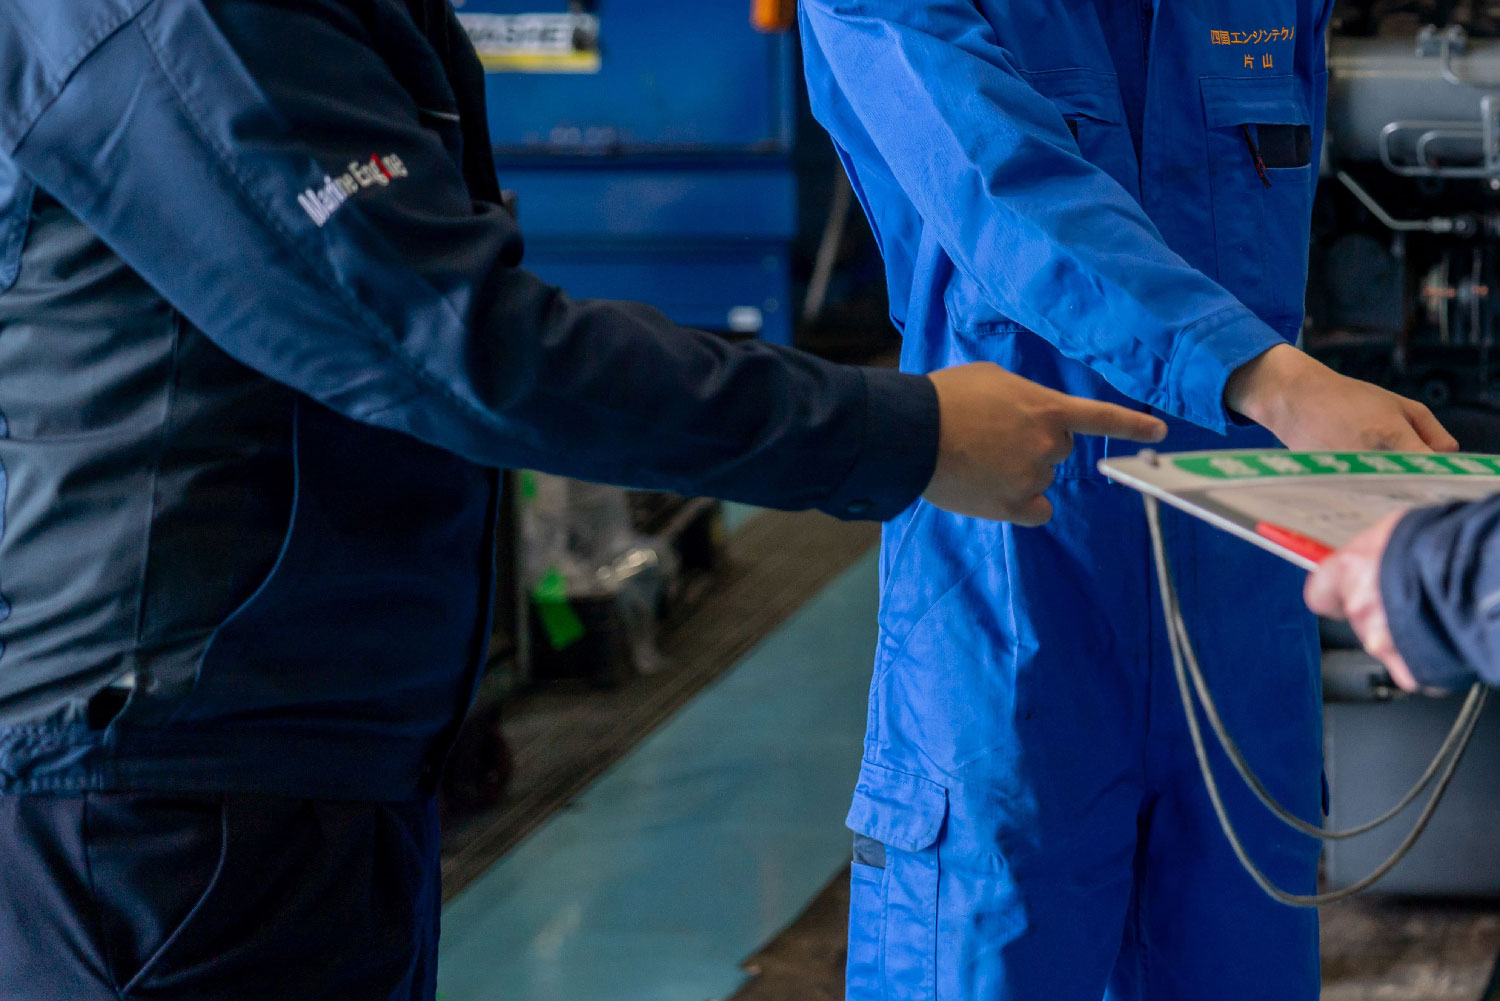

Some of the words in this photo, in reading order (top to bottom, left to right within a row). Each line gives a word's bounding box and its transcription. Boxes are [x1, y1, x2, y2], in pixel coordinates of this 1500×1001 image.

[1210, 25, 1294, 45] 四国エンジンテクノ
[298, 175, 358, 227] Marine
[348, 153, 408, 188] Engine
